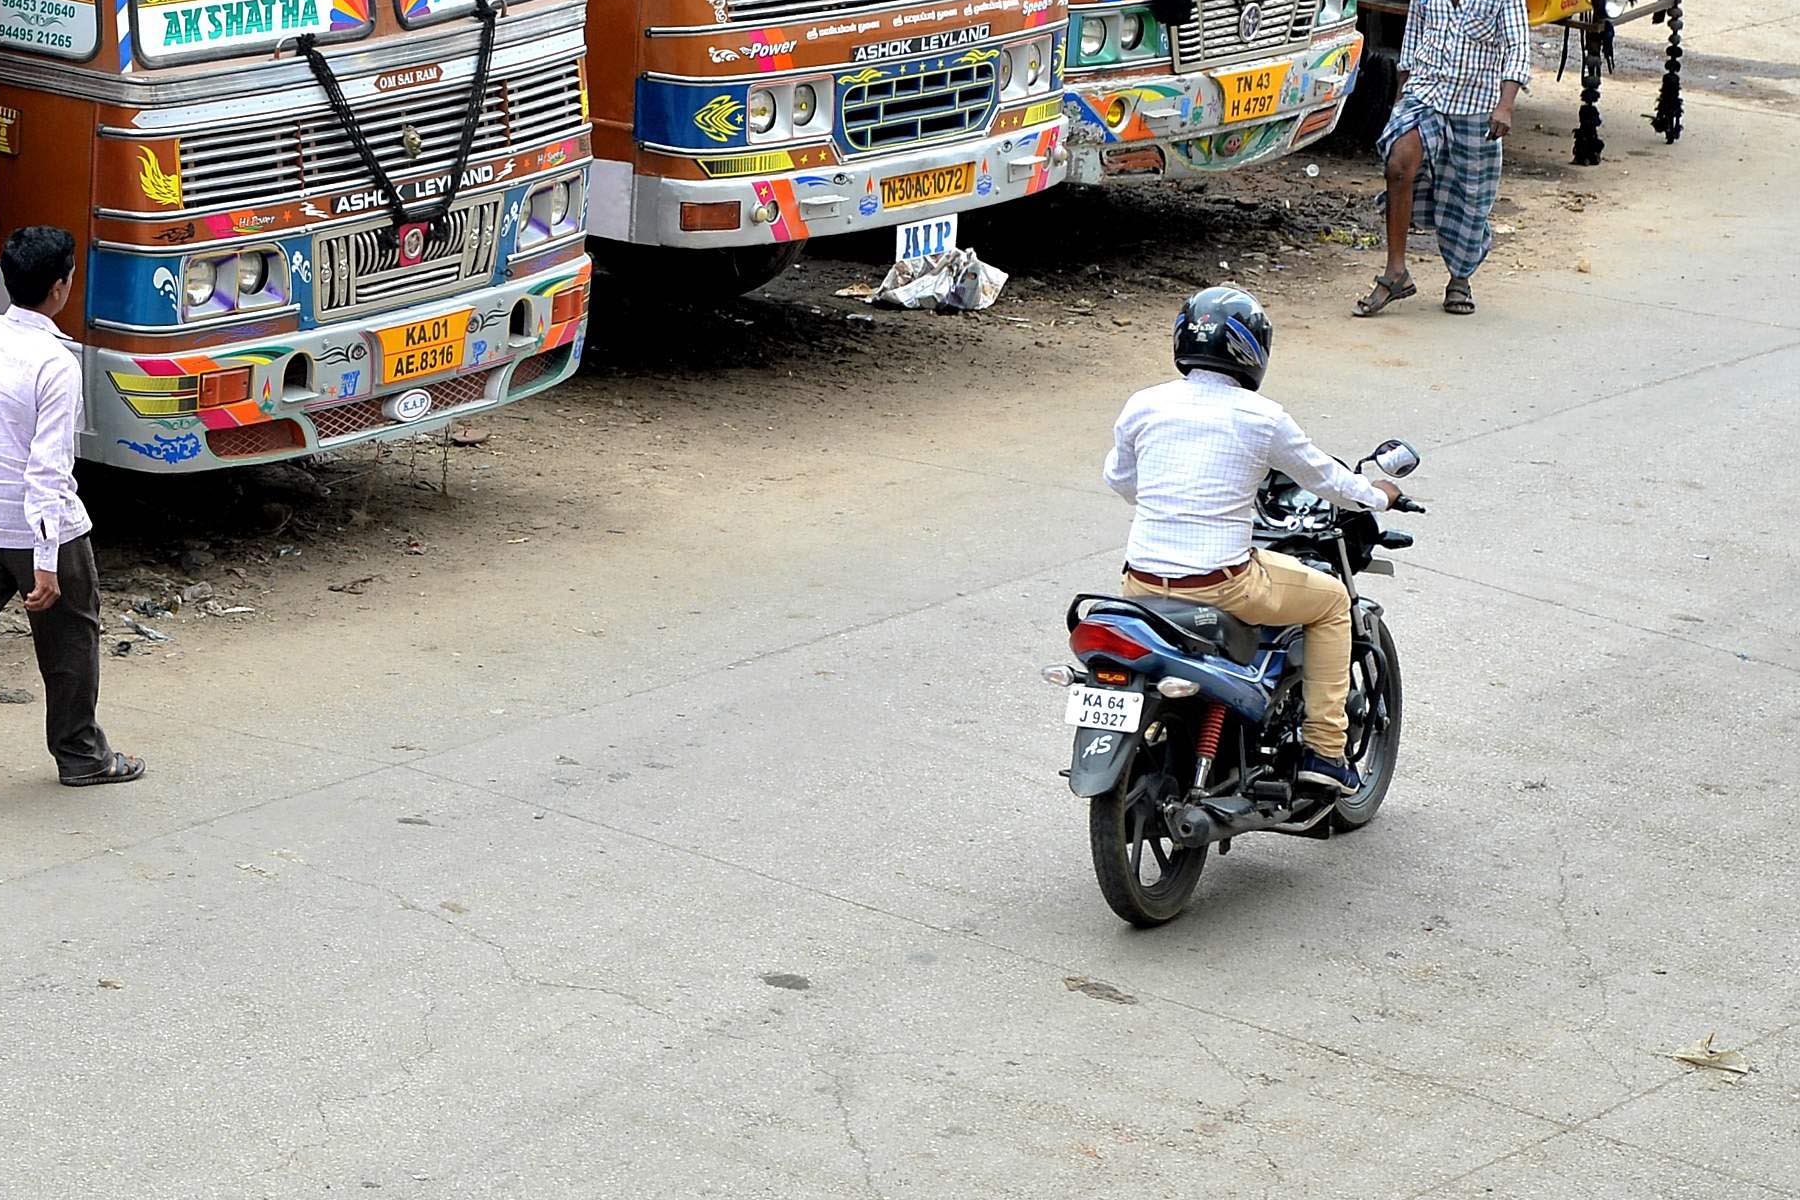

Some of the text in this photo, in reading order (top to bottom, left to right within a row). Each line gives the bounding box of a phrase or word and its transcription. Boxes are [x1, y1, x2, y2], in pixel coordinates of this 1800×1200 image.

[39, 0, 76, 20] 20640
[36, 28, 73, 50] 21265
[751, 39, 798, 60] Power
[855, 25, 990, 63] ASHOK LEYLAND
[379, 67, 439, 89] OM SAI RAM
[1236, 72, 1271, 94] TN 43
[1231, 95, 1274, 117] H 4797
[335, 166, 495, 216] ASHOK LEYLAND
[404, 320, 450, 347] KA.01
[392, 341, 455, 380] AE.8316
[1082, 693, 1125, 711] KA 64
[1079, 710, 1128, 728] J 9327
[1082, 734, 1113, 759] AS
